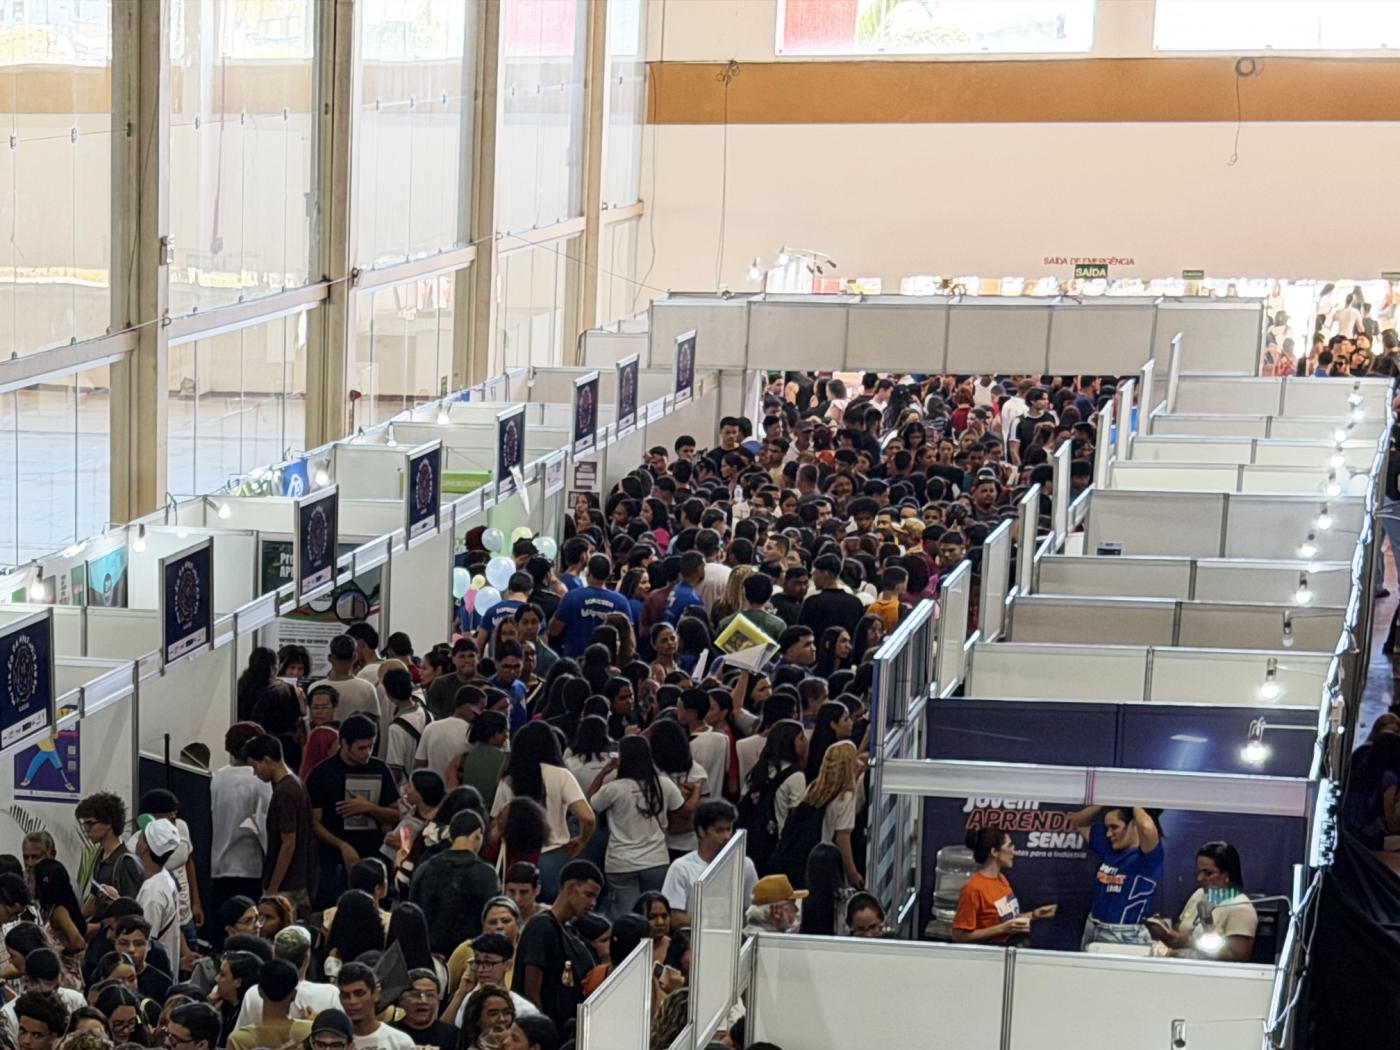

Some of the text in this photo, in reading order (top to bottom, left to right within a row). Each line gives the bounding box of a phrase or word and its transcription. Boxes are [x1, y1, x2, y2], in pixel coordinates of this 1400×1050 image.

[1076, 266, 1107, 278] SAÍDA
[966, 808, 1078, 832] APRENDI
[1027, 832, 1083, 849] SENAI
